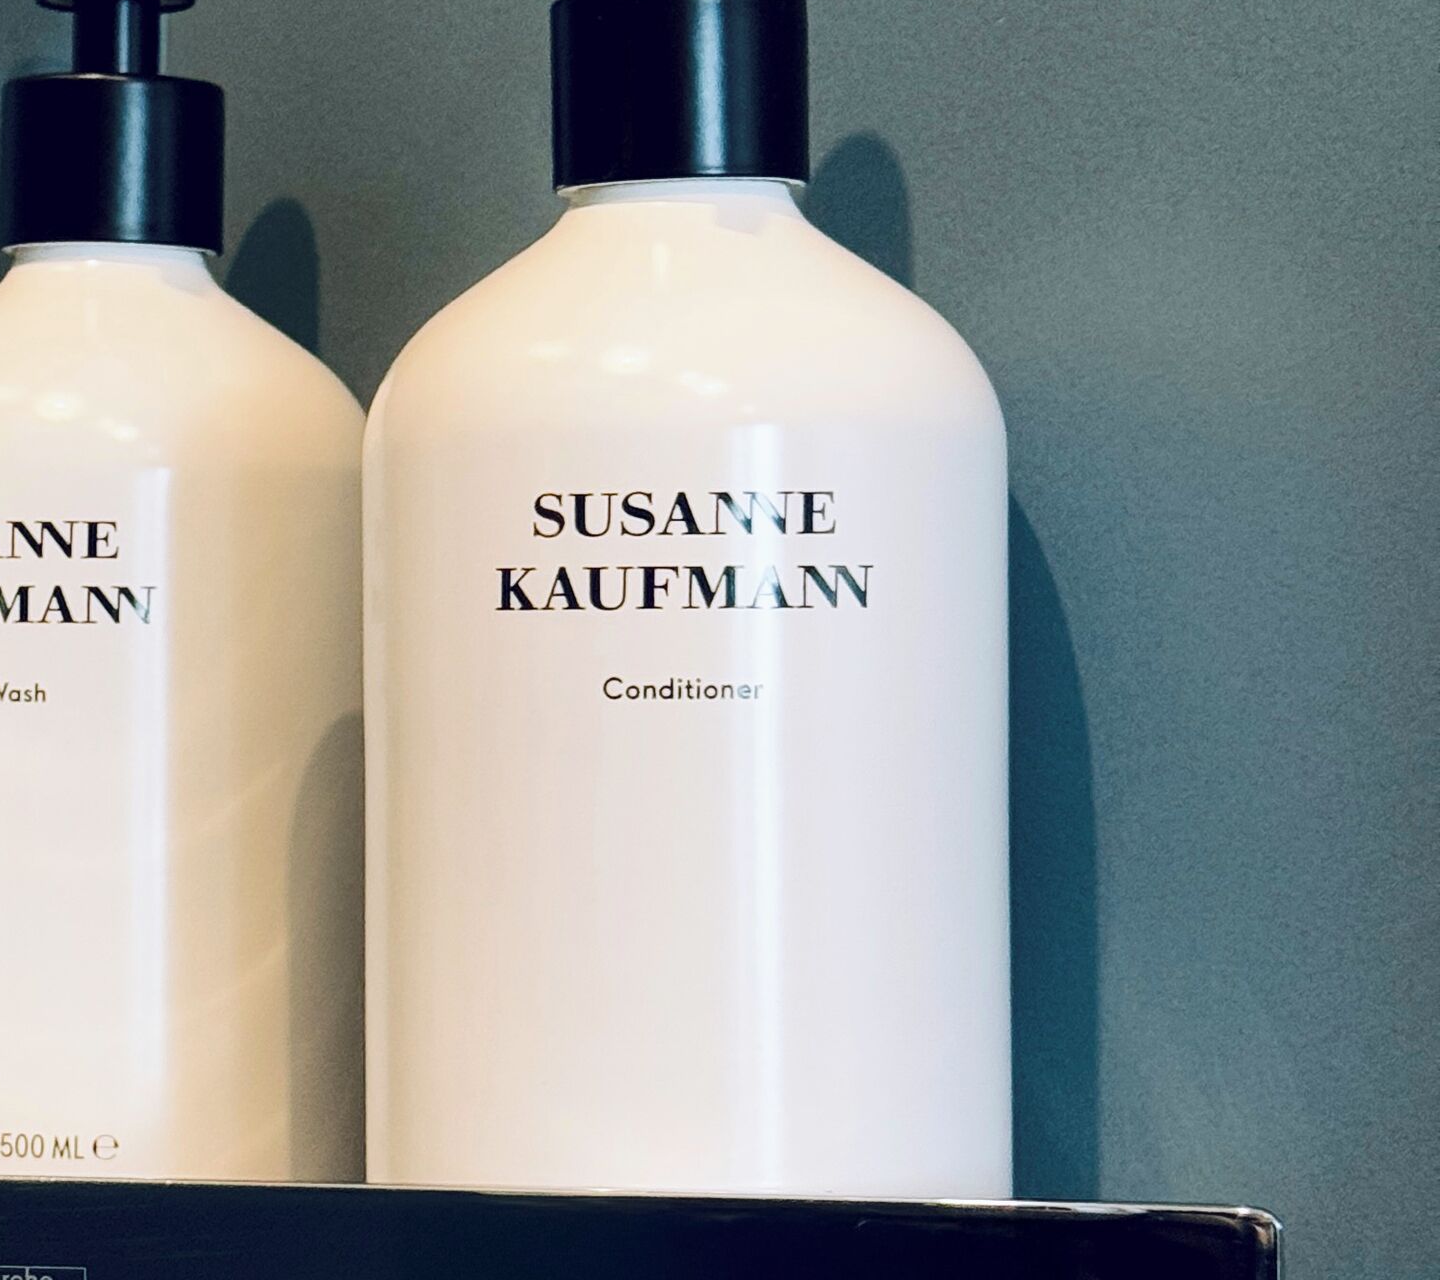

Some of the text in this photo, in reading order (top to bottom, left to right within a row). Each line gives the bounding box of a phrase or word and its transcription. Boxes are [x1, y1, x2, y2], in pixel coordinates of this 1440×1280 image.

[533, 491, 836, 538] SUSANNE
[495, 565, 873, 610] KAUFMANN
[603, 676, 764, 700] Conditioner
[0, 1133, 45, 1158] 500
[52, 1136, 84, 1160] ML
